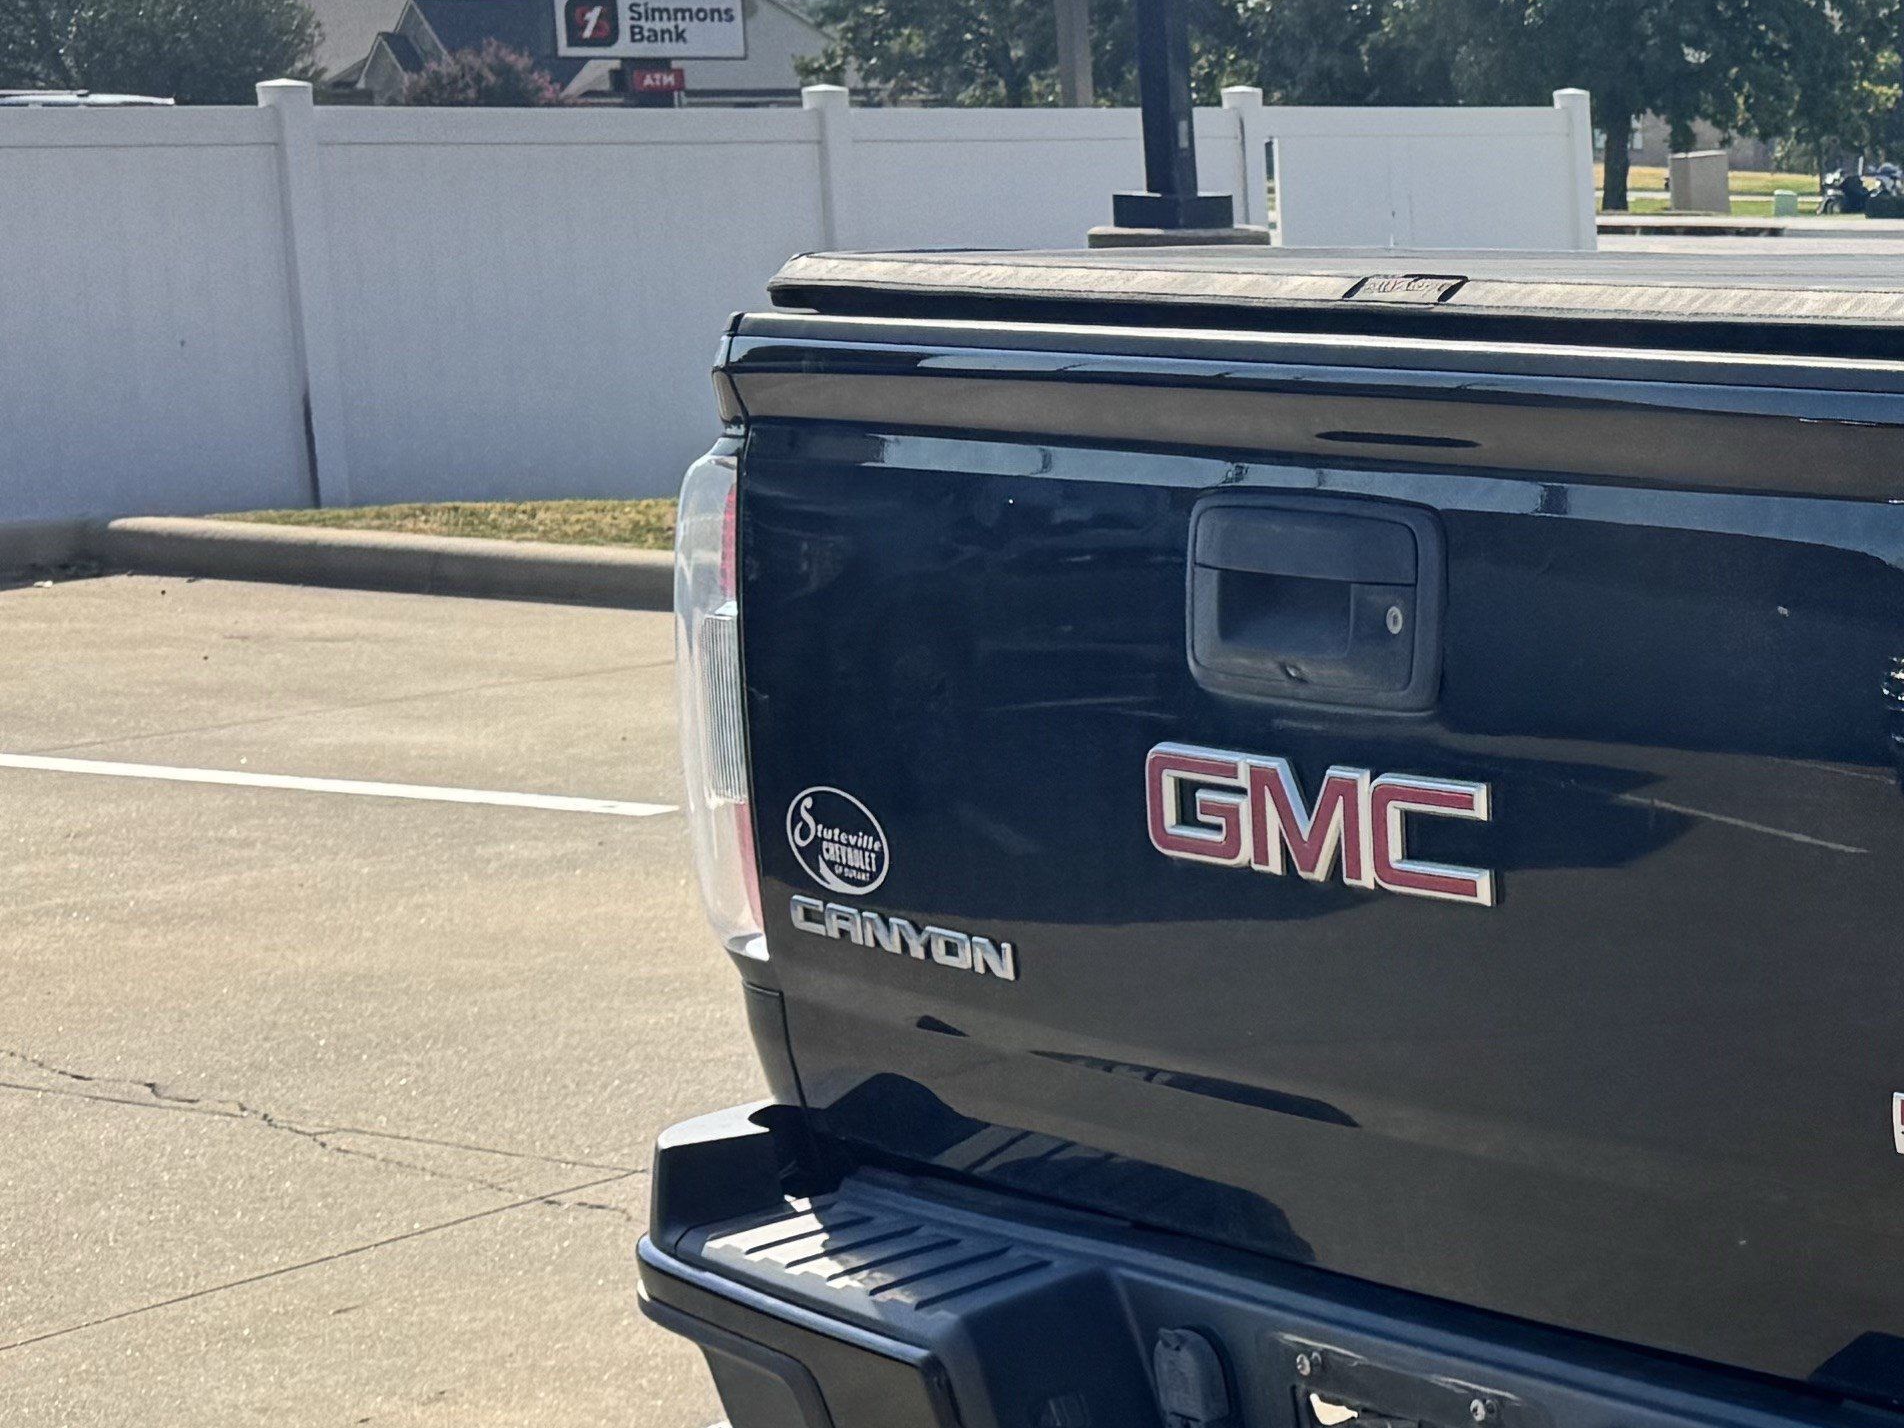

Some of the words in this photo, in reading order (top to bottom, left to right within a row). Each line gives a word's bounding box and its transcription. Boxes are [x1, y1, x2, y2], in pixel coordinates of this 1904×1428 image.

[628, 2, 735, 22] Simmons
[630, 25, 687, 43] Bank
[794, 797, 881, 852] Stuteville
[1145, 741, 1496, 907] GMC
[822, 841, 877, 872] CHEVROLET
[790, 894, 1015, 981] CANYON
